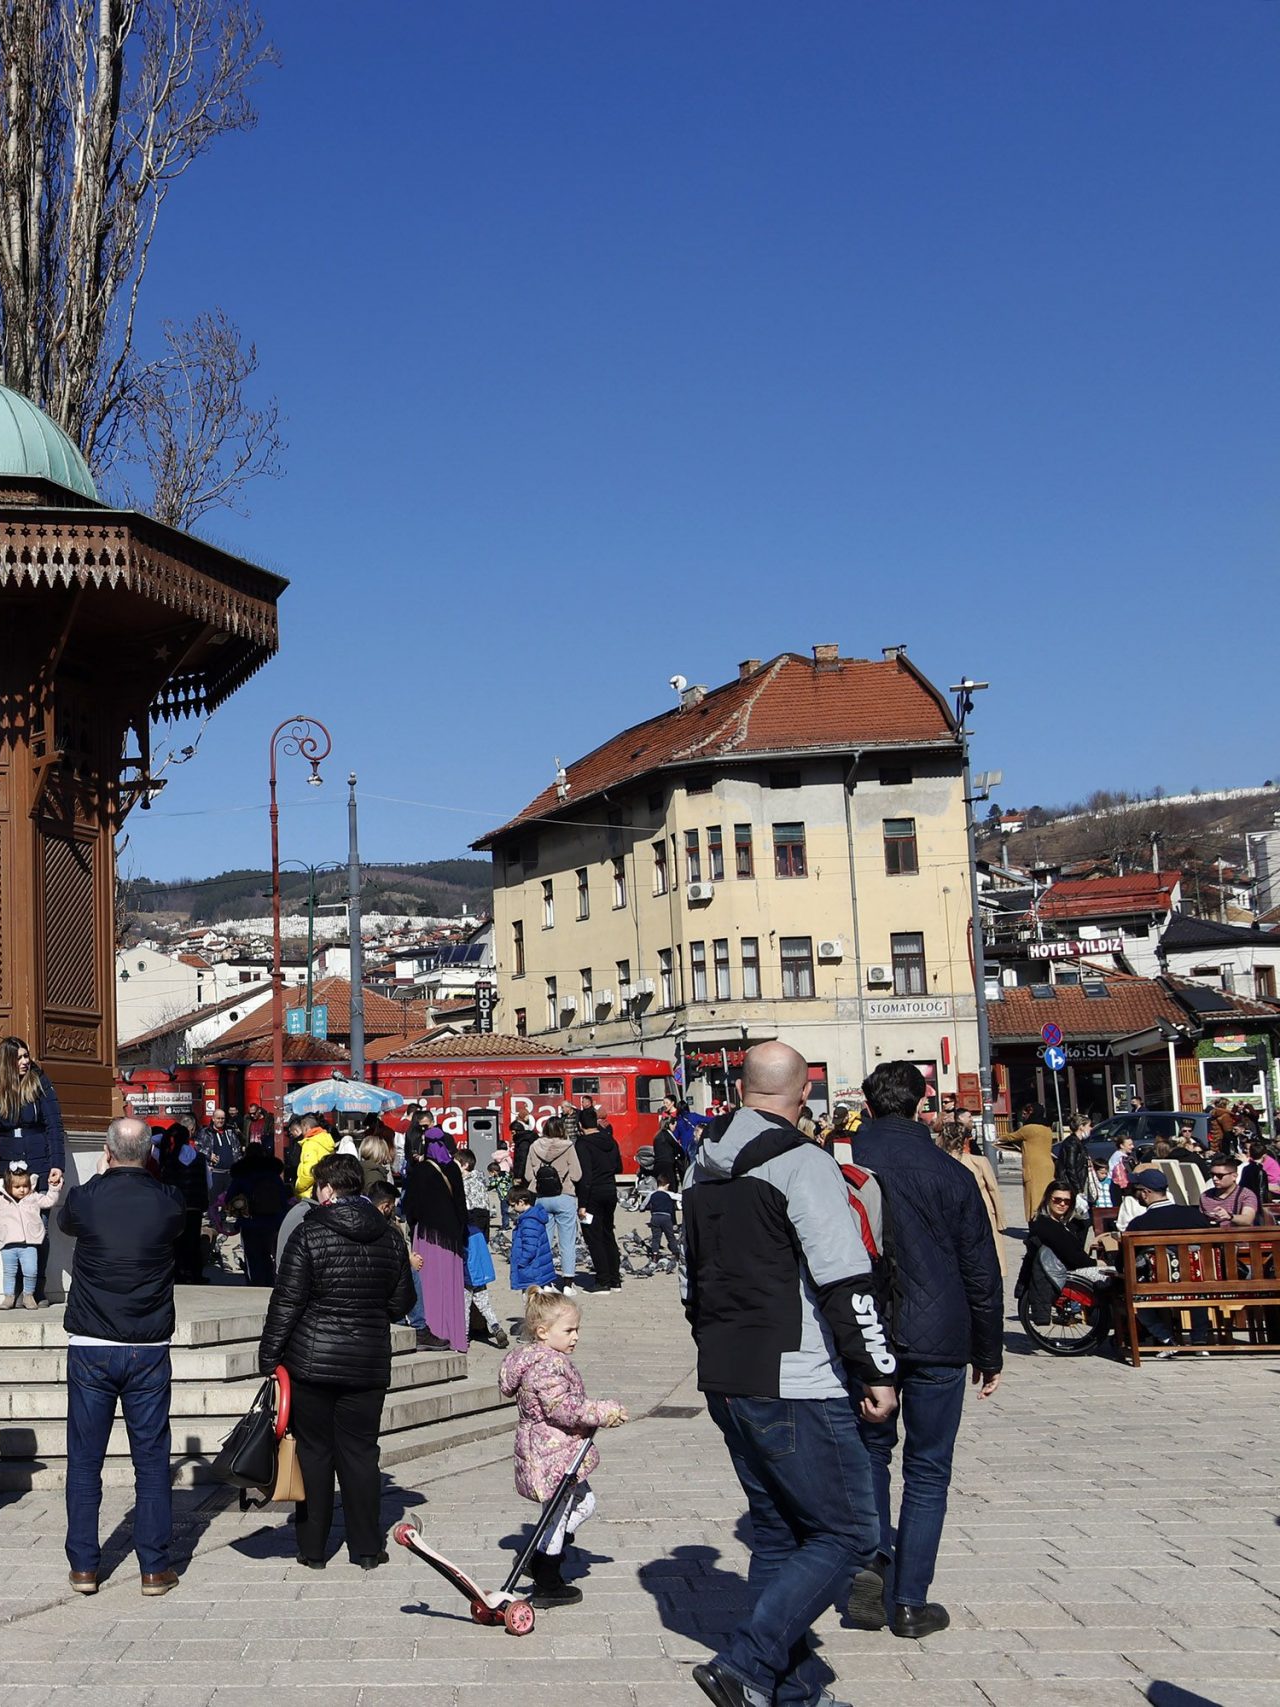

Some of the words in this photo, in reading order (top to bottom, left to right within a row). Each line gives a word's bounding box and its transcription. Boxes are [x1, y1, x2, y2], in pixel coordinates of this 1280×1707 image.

[1030, 943, 1074, 959] HOTEL
[1076, 938, 1121, 955] YILDIZ
[870, 1001, 943, 1014] STOMATOLOG
[851, 1293, 897, 1375] STWD
